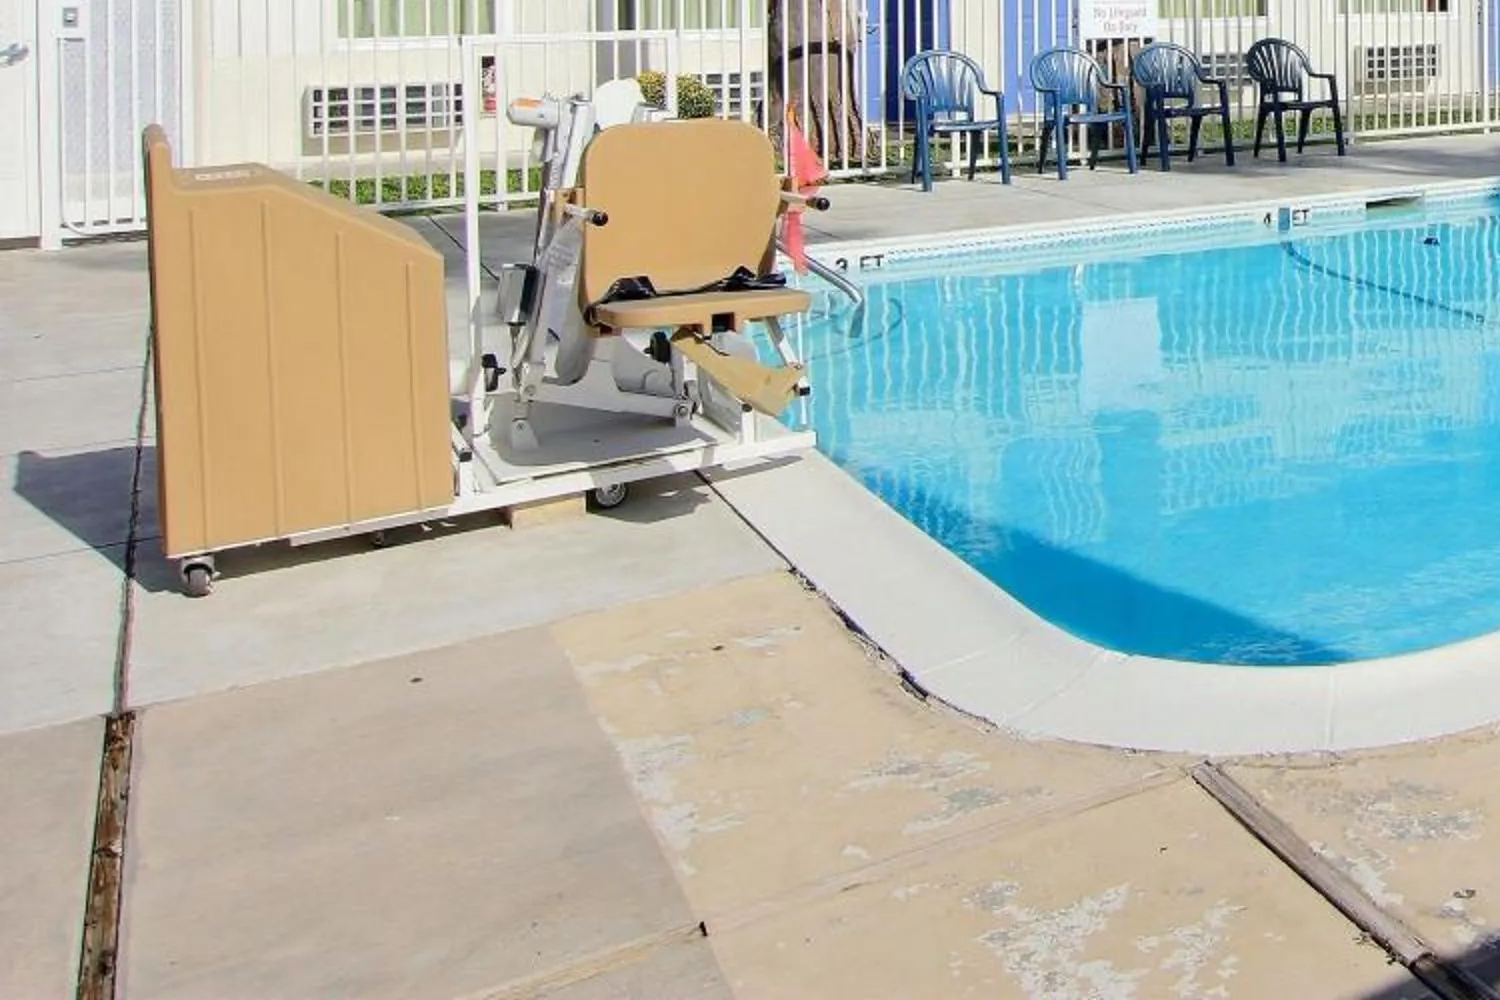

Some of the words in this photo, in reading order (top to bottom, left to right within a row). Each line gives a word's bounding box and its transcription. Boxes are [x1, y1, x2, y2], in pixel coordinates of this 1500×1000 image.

[1292, 208, 1310, 225] FT
[835, 257, 848, 271] 3
[860, 254, 884, 270] FT
